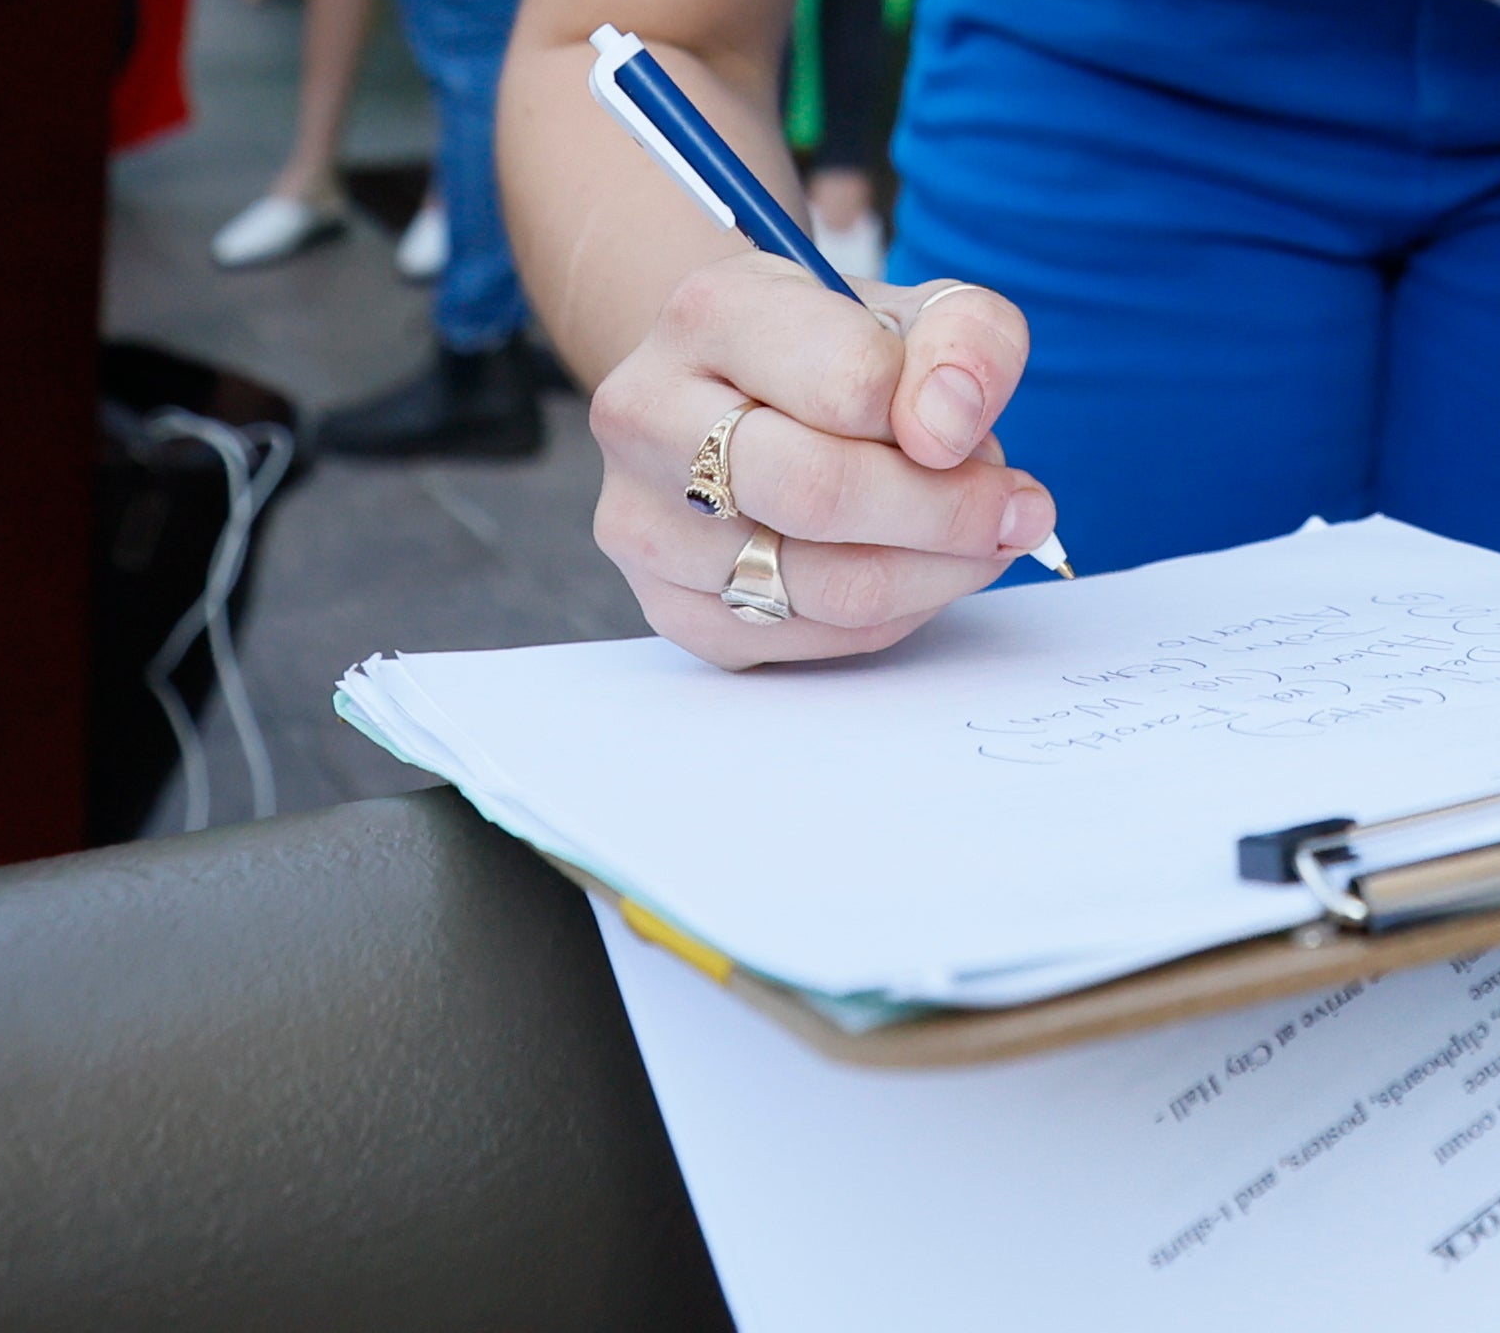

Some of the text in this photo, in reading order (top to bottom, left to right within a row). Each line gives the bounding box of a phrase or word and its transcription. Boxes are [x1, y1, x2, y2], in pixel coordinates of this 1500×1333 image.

[1157, 605, 1351, 649] Alberto
[1223, 621, 1388, 653] John
[1300, 978, 1365, 1029] arrive
[1273, 1022, 1298, 1049] at
[1224, 1040, 1275, 1080] City
[1168, 1074, 1223, 1122] Hall
[1433, 1111, 1496, 1166] count
[1232, 1169, 1278, 1215] and
